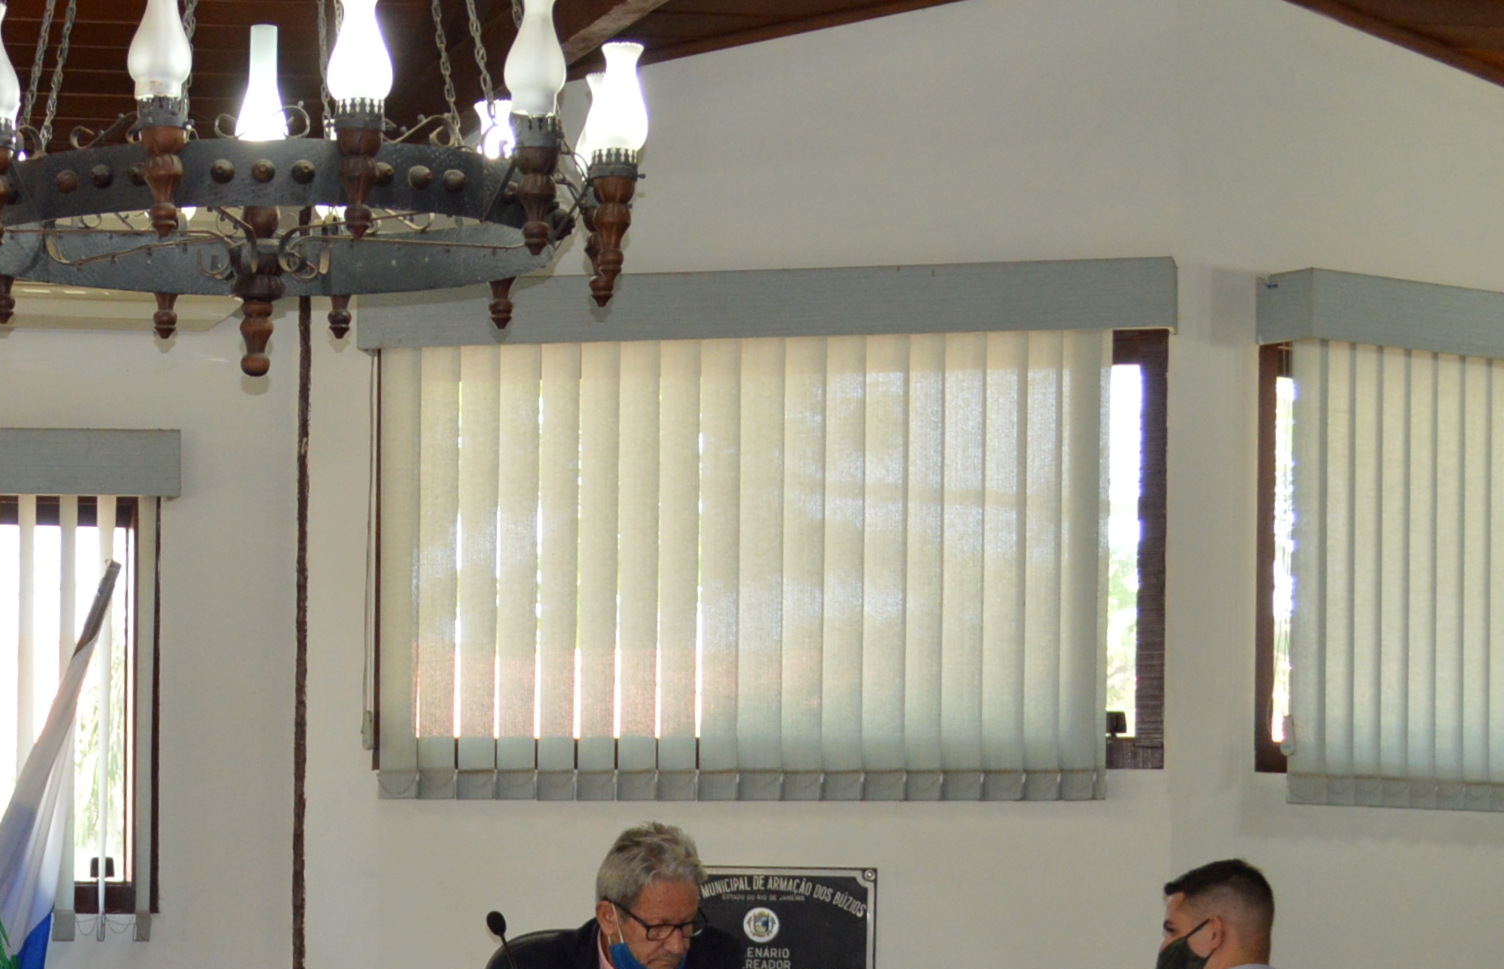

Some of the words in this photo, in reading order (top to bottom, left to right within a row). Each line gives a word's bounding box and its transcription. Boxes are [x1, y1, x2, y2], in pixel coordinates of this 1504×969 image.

[700, 876, 751, 898] MUNICIPAL
[753, 875, 765, 890] DE
[767, 876, 812, 896] ARMAÇÃO
[813, 884, 832, 902] DOS
[833, 891, 867, 918] BÚZIOS
[745, 946, 790, 959] ENÁRIO
[743, 960, 791, 969] READOR
